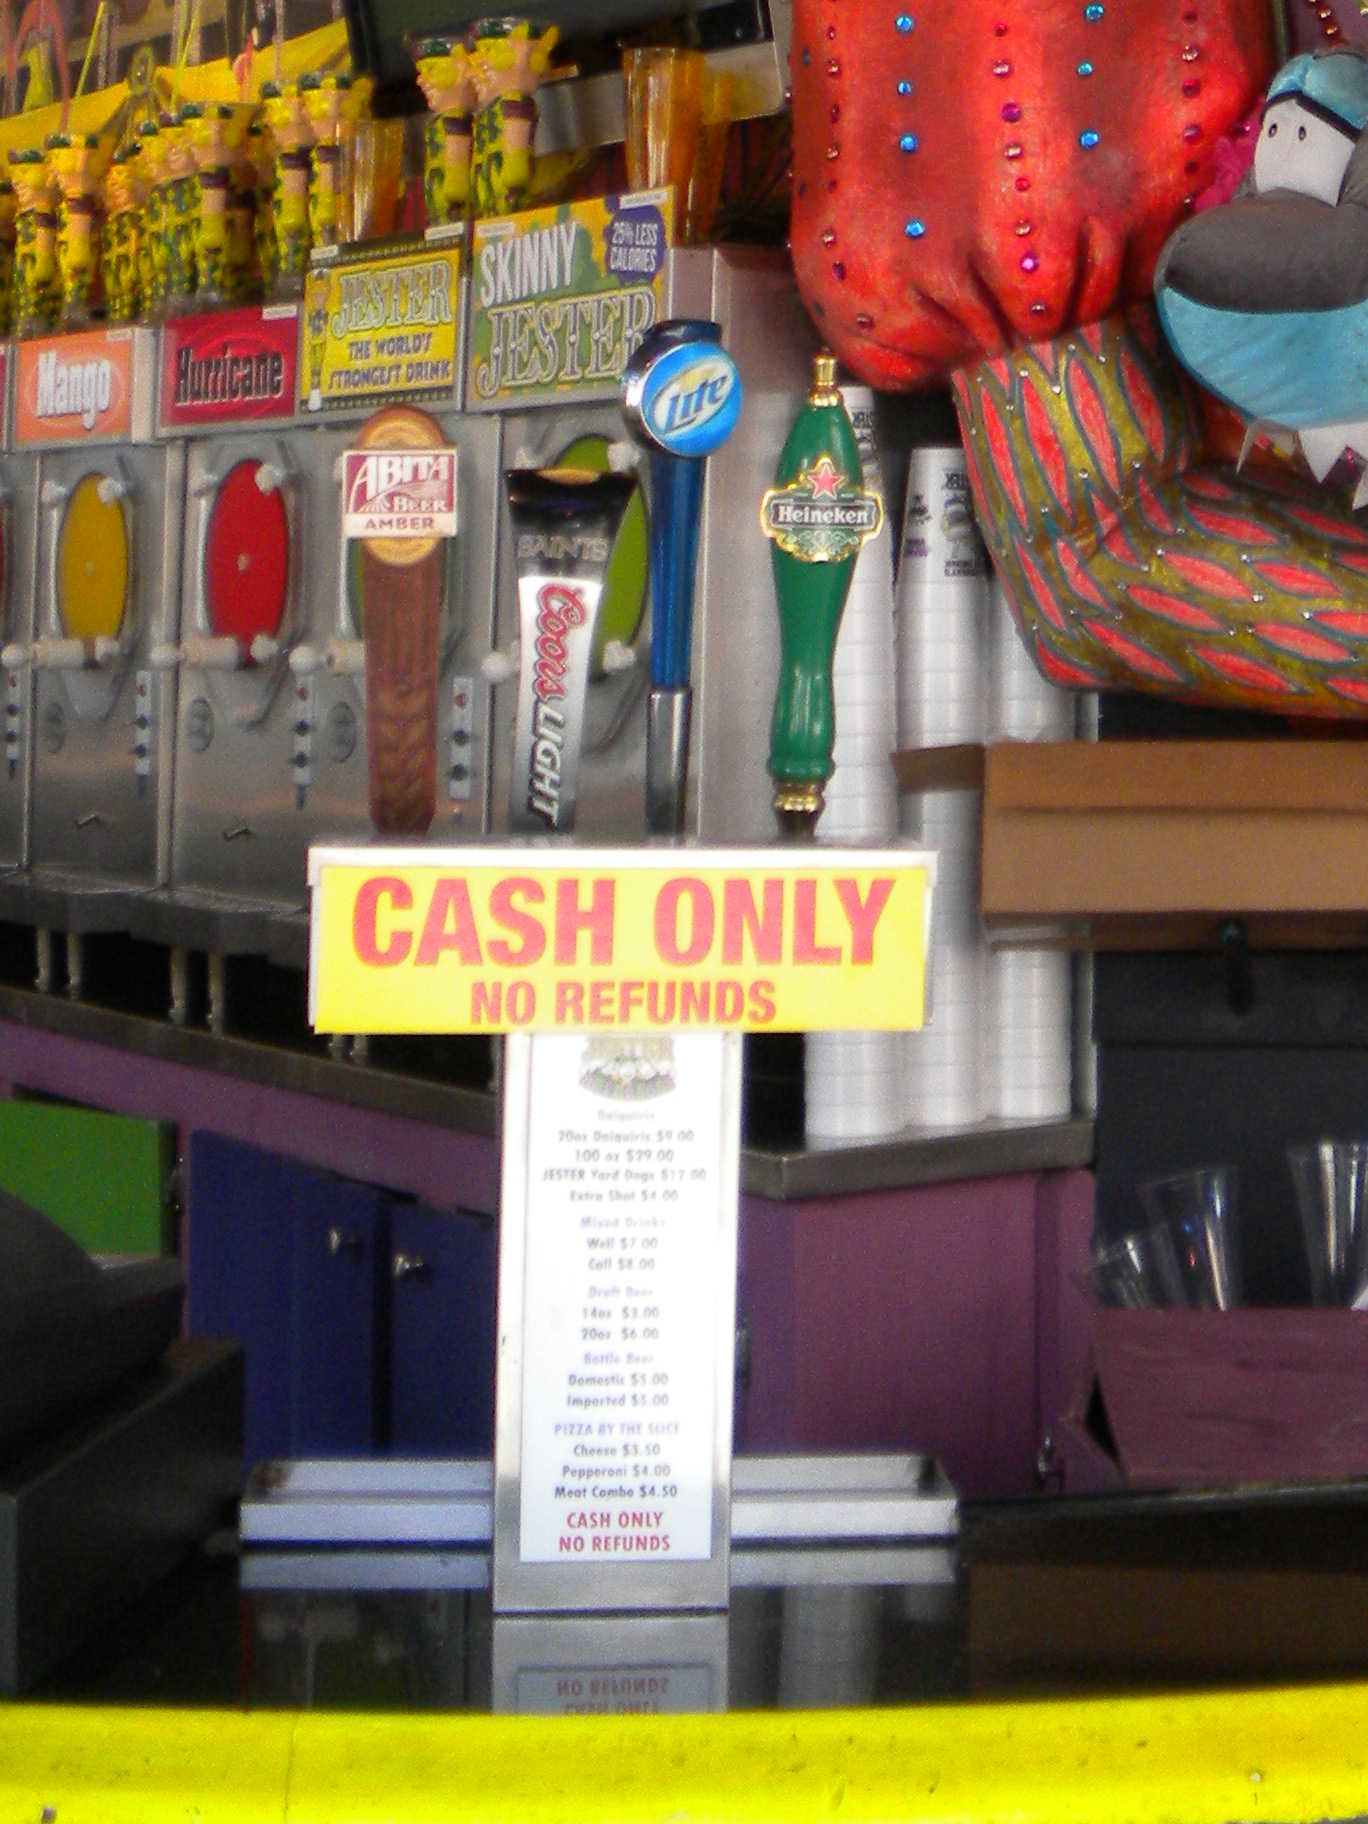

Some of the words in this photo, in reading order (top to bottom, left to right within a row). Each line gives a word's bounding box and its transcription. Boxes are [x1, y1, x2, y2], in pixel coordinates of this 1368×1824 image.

[479, 221, 577, 307] SKINNY
[635, 224, 658, 245] LESS
[610, 248, 657, 272] CALORIES
[331, 260, 453, 338] JESTER
[349, 340, 371, 360] THE
[476, 286, 656, 398] JESTER
[175, 344, 284, 406] Hurricane
[328, 364, 401, 389] STRONGEST
[405, 360, 451, 382] DRINK
[36, 350, 111, 430] Mango
[664, 375, 729, 432] Lite
[350, 454, 450, 503] ABITA
[365, 516, 435, 529] AMBER
[778, 505, 868, 524] Heineken
[535, 582, 586, 699] Coors
[528, 699, 565, 831] LIGHT
[352, 876, 616, 967] CASH
[653, 877, 897, 966] ONLY
[470, 980, 535, 1024] NO
[555, 980, 777, 1024] REFUNDS
[575, 1149, 600, 1162] 100
[543, 1168, 585, 1181] JESTER
[570, 1189, 603, 1202] Extra
[586, 1237, 614, 1249] Well
[588, 1258, 612, 1271] Call
[568, 1373, 625, 1386] Domestic
[566, 1394, 625, 1409] Imported
[553, 1423, 592, 1436] PIZZA
[573, 1444, 617, 1457] Cheese
[562, 1464, 626, 1480] Pepperoni
[555, 1484, 587, 1499] Meat
[591, 1484, 634, 1499] Combo
[639, 1484, 678, 1499] $4.50
[567, 1511, 611, 1529] CASH
[618, 1510, 663, 1529] ONLY
[559, 1536, 585, 1552] NO
[592, 1534, 671, 1552] REFUNDS
